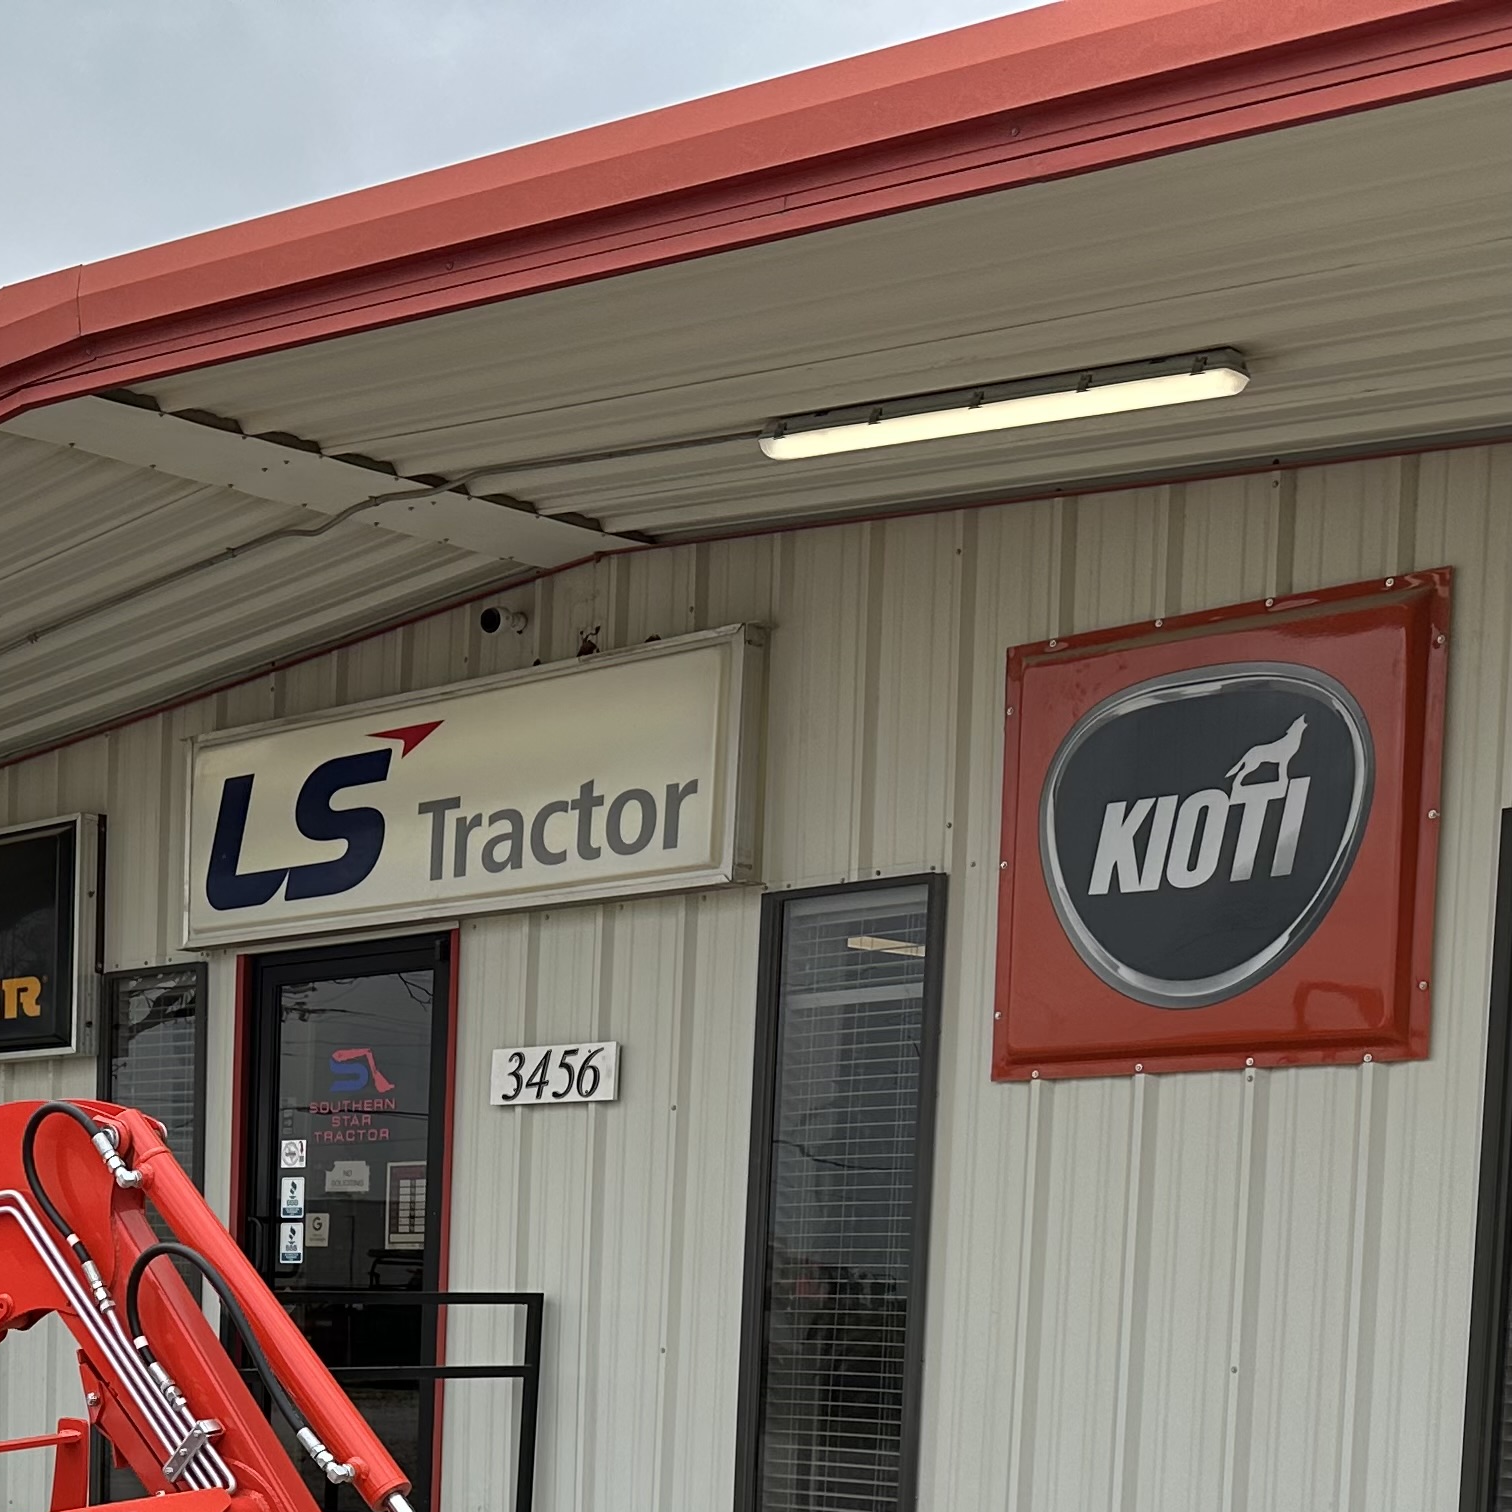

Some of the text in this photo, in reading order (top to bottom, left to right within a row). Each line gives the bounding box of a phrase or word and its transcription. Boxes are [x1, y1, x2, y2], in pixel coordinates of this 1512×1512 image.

[205, 747, 699, 911] LS Tractor
[1088, 775, 1311, 896] KIOTI
[501, 1047, 605, 1101] 3456
[309, 1098, 396, 1114] SOUTHERN
[331, 1114, 372, 1127] STAR
[314, 1128, 390, 1144] TRACTOR
